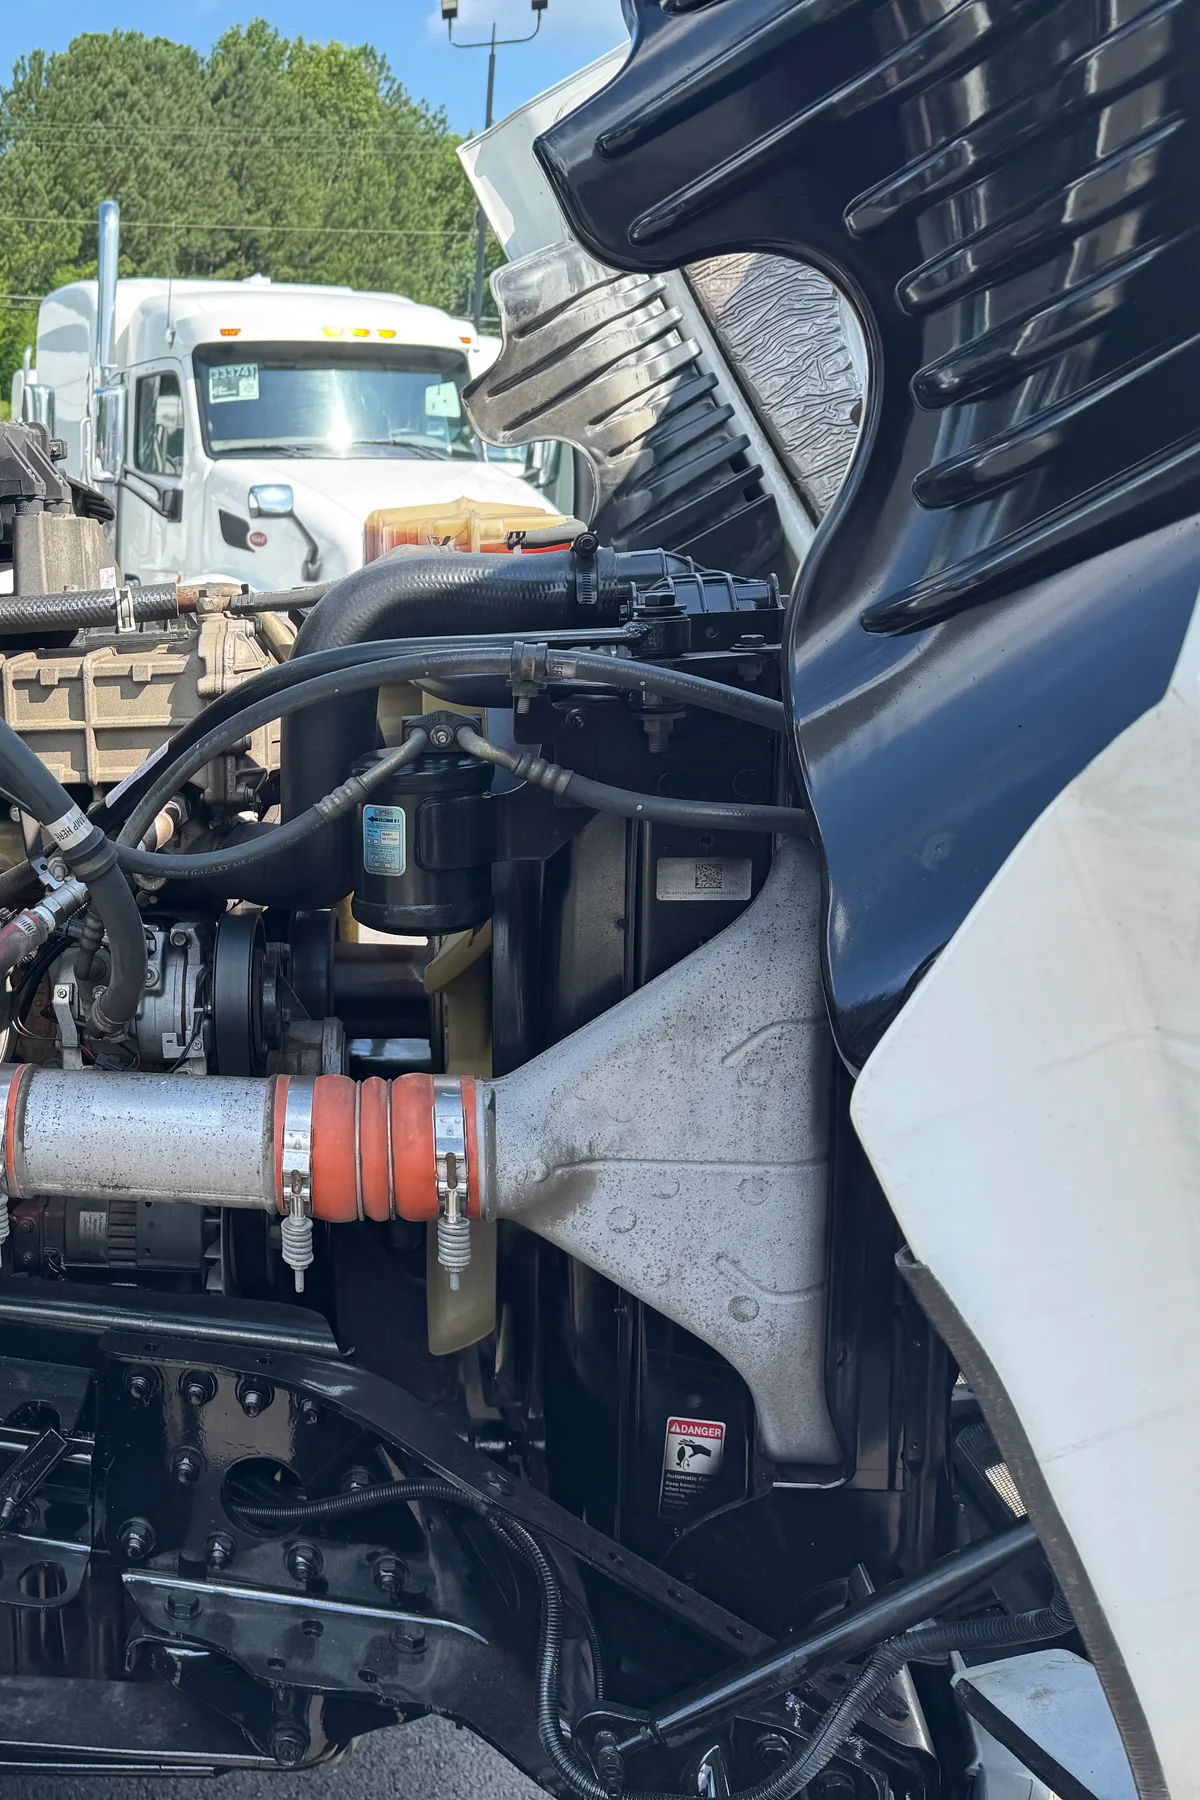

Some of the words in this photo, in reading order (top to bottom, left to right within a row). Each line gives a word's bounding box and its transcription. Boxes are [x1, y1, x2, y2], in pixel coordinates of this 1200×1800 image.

[54, 826, 73, 841] HERE
[191, 863, 230, 876] GALAXY
[681, 1424, 722, 1437] DANGER
[666, 1473, 698, 1482] Automatic
